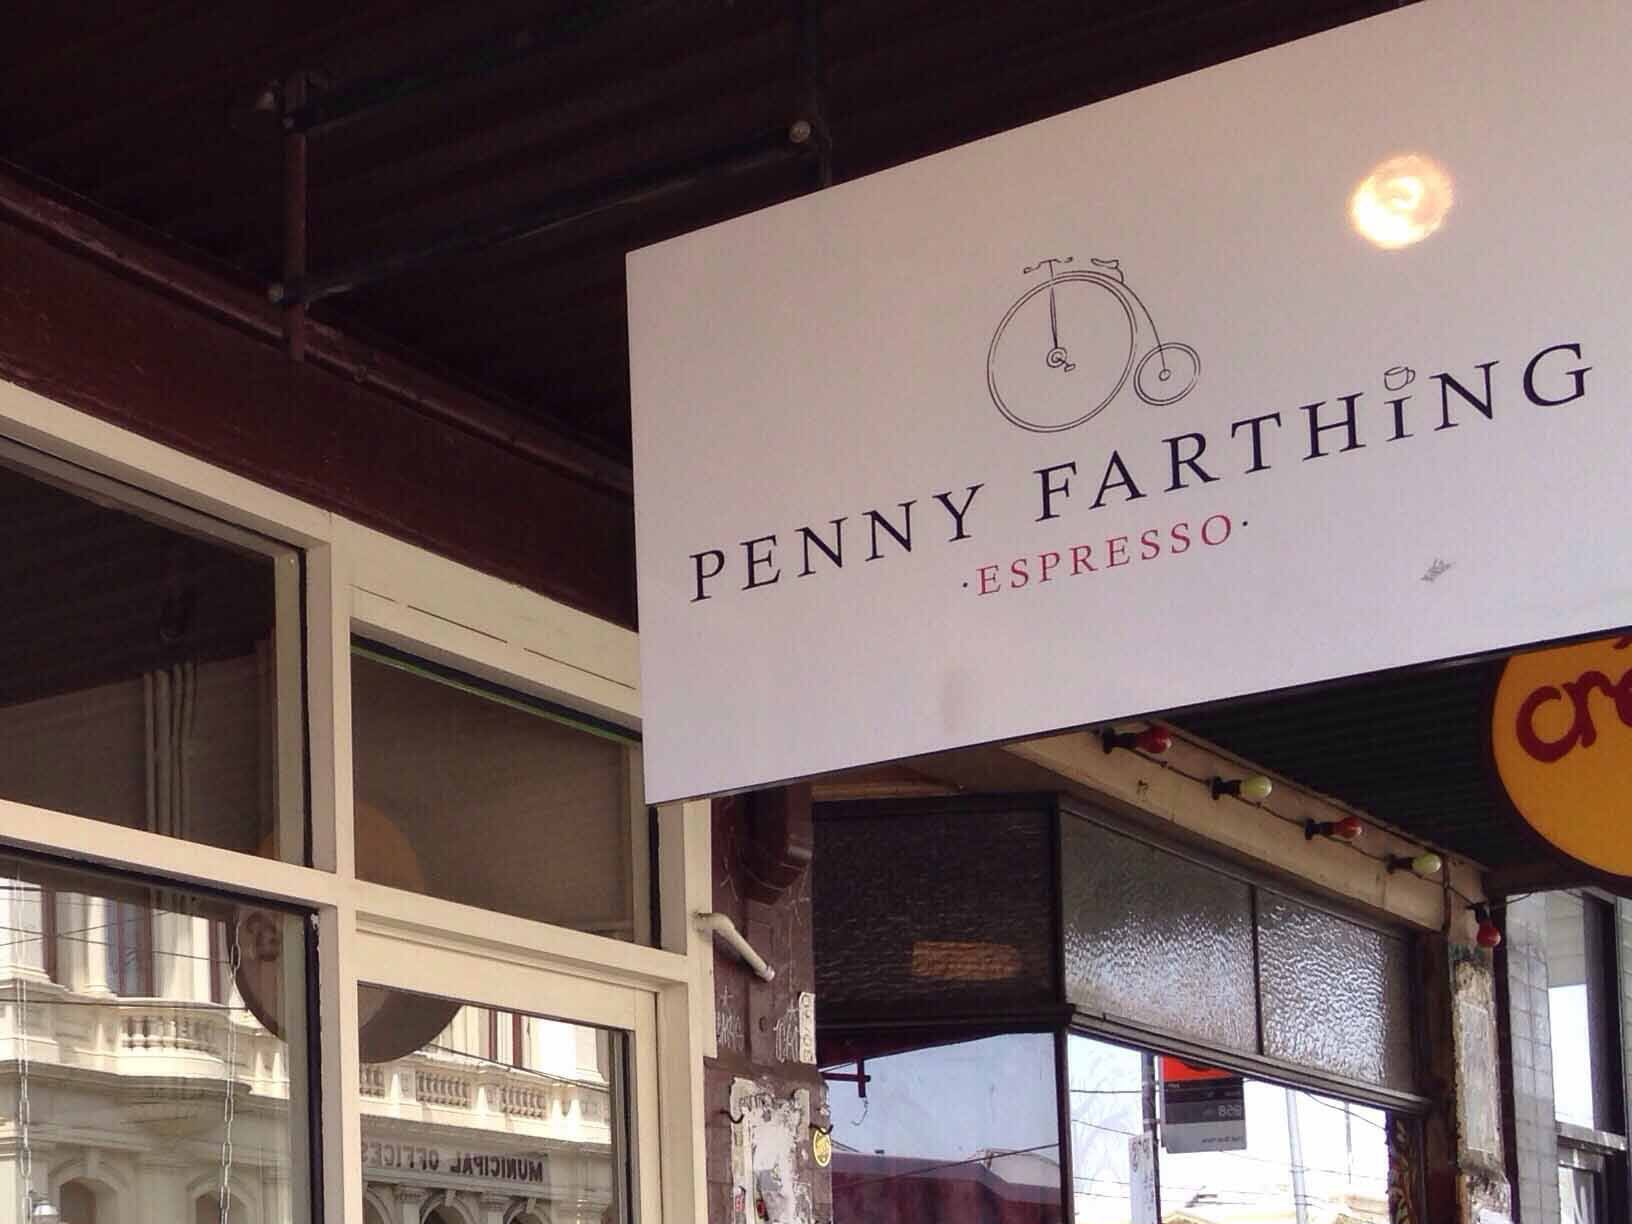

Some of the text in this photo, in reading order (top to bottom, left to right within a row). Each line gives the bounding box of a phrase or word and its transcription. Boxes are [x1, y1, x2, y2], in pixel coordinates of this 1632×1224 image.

[689, 343, 1595, 603] PENNY FARTHING
[977, 513, 1234, 598] ESPRESSO
